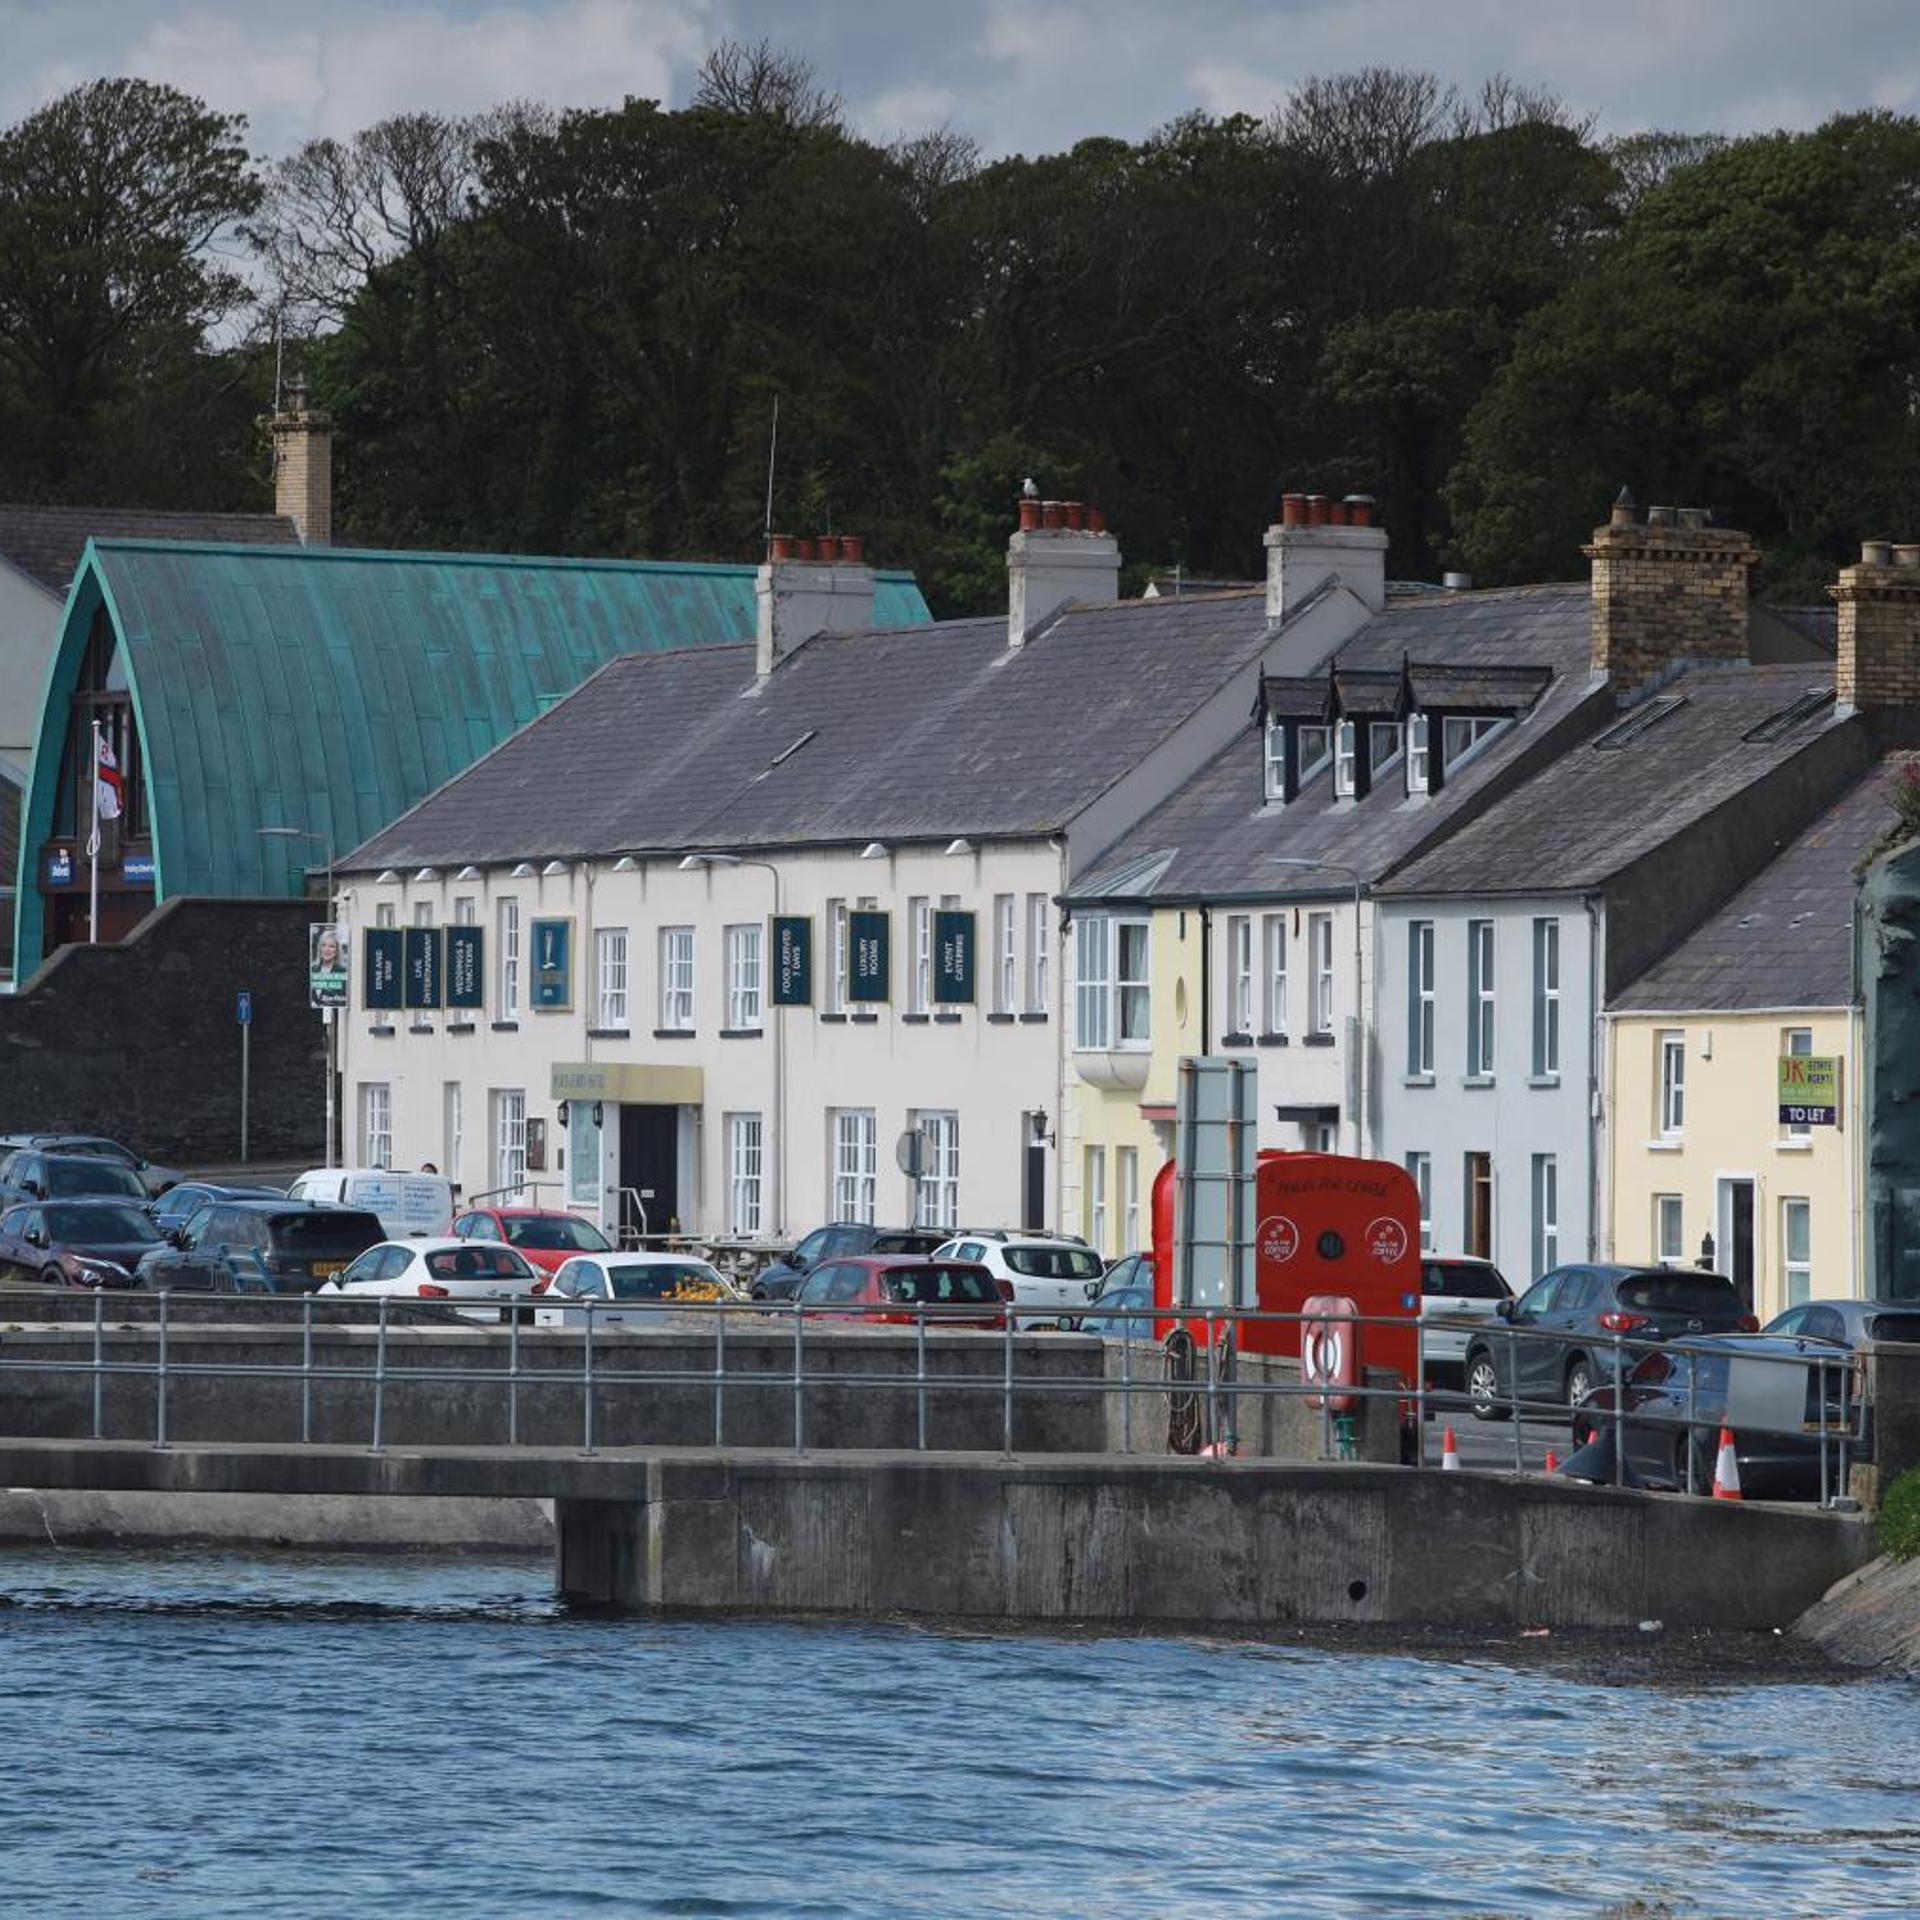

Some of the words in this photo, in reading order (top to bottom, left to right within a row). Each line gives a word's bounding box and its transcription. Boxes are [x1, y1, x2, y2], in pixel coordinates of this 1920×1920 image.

[783, 928, 791, 965] SERVED
[792, 946, 801, 969] DAYS
[859, 938, 868, 977] LUXURY
[869, 939, 878, 975] ROOMS
[944, 942, 953, 974] EVENT
[955, 934, 964, 982] CATERING
[423, 933, 432, 1004] ENTERTAINMENT
[455, 948, 464, 996] WEDDINGS
[465, 942, 473, 993] FUNCTIONS
[782, 967, 791, 994] FOOD
[1782, 1059, 1805, 1086] JK
[1789, 1108, 1806, 1121] TO
[1807, 1108, 1826, 1122] LET
